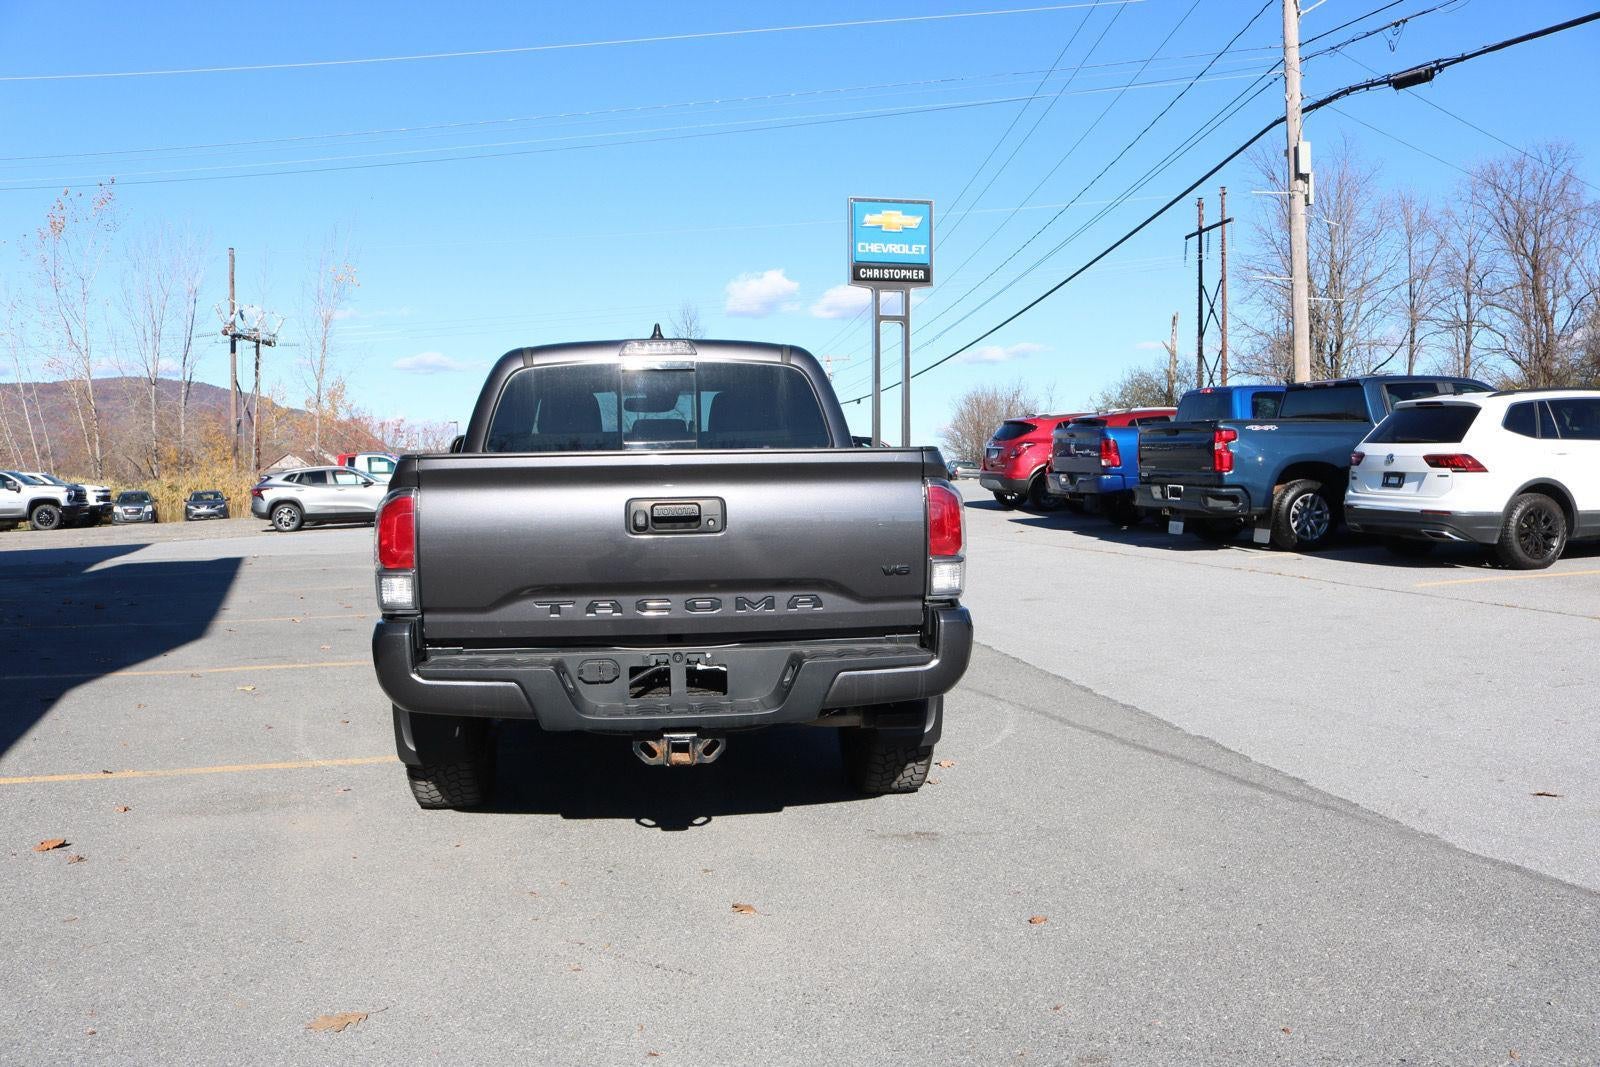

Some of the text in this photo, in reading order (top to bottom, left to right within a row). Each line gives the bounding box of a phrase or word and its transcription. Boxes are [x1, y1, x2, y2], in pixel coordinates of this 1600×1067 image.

[857, 242, 927, 255] CHEVROLET
[860, 268, 925, 279] CHRISTOPHER
[655, 506, 698, 516] TOYOTA
[881, 564, 910, 576] V6
[533, 594, 824, 618] TACOMA
